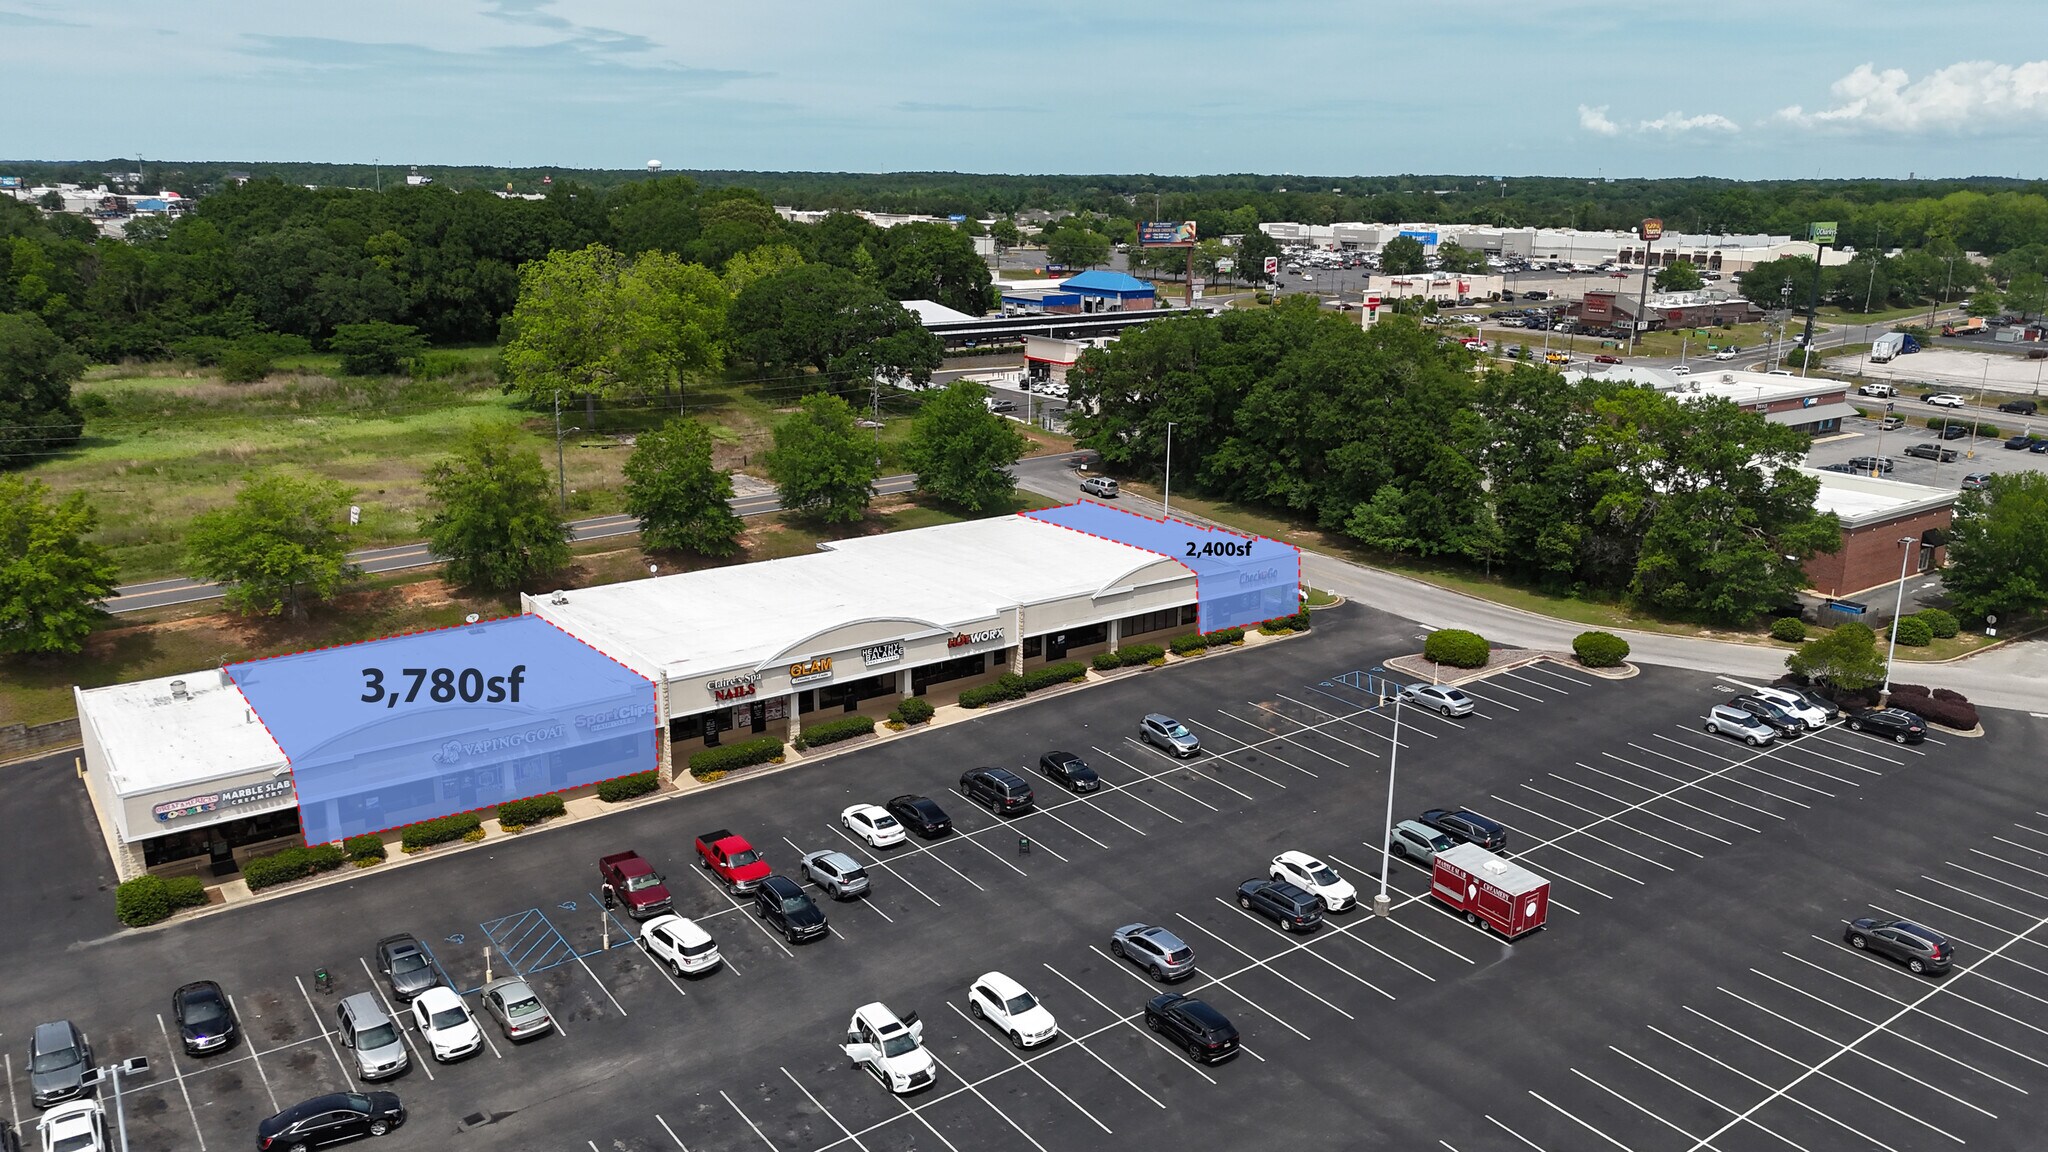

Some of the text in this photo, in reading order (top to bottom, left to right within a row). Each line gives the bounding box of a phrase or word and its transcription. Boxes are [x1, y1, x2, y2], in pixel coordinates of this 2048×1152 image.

[862, 642, 900, 657] HEALTHY
[865, 647, 904, 661] BALANCE
[790, 657, 833, 677] GLAM
[743, 673, 762, 684] Spa
[715, 683, 756, 702] NAILS
[463, 724, 566, 756] VAPING GOAT
[222, 780, 291, 801] MARBLE SLAB
[231, 790, 283, 805] CREAMERY
[156, 795, 218, 813] GREAT AMERICAN
[159, 804, 217, 821] COOKIES
